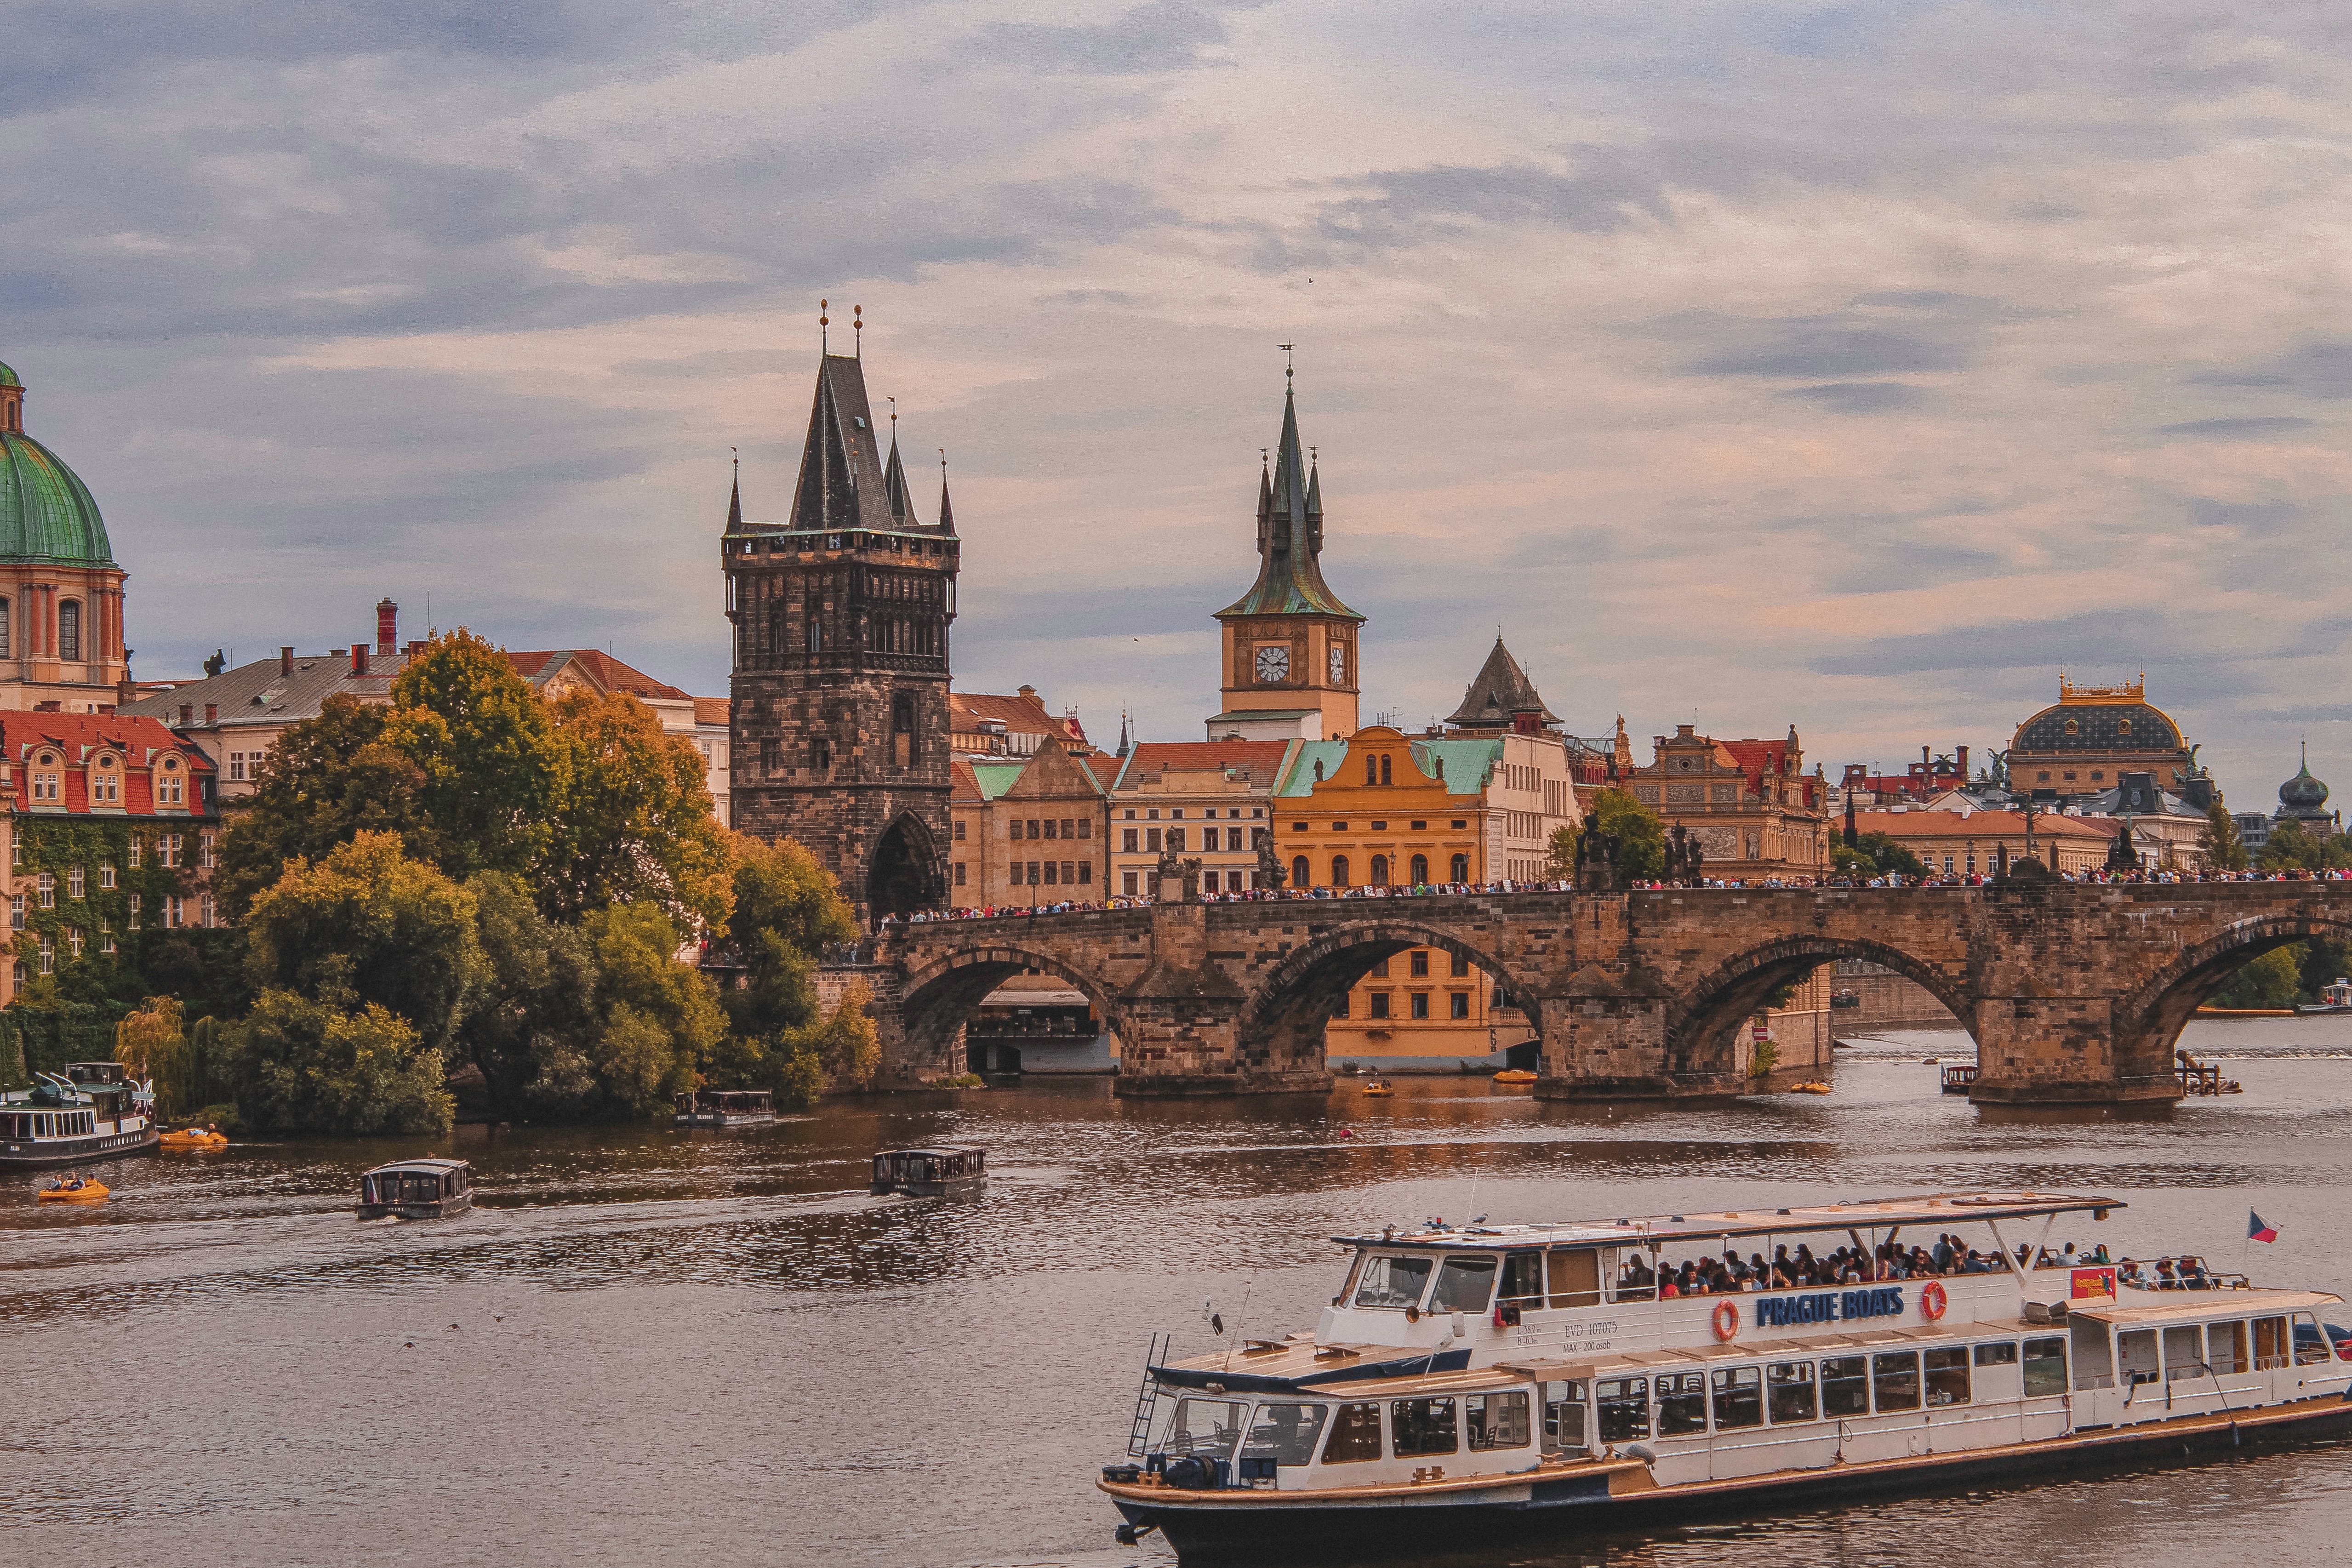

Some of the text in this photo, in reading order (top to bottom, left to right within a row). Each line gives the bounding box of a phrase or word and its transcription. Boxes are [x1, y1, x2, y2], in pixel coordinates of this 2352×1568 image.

[1757, 1287, 1904, 1327] PRAGUE BOATS
[1565, 1321, 1618, 1337] EVD 107075
[1563, 1343, 1578, 1353] MAX
[1584, 1342, 1595, 1351] 200
[1596, 1340, 1611, 1350] osob
